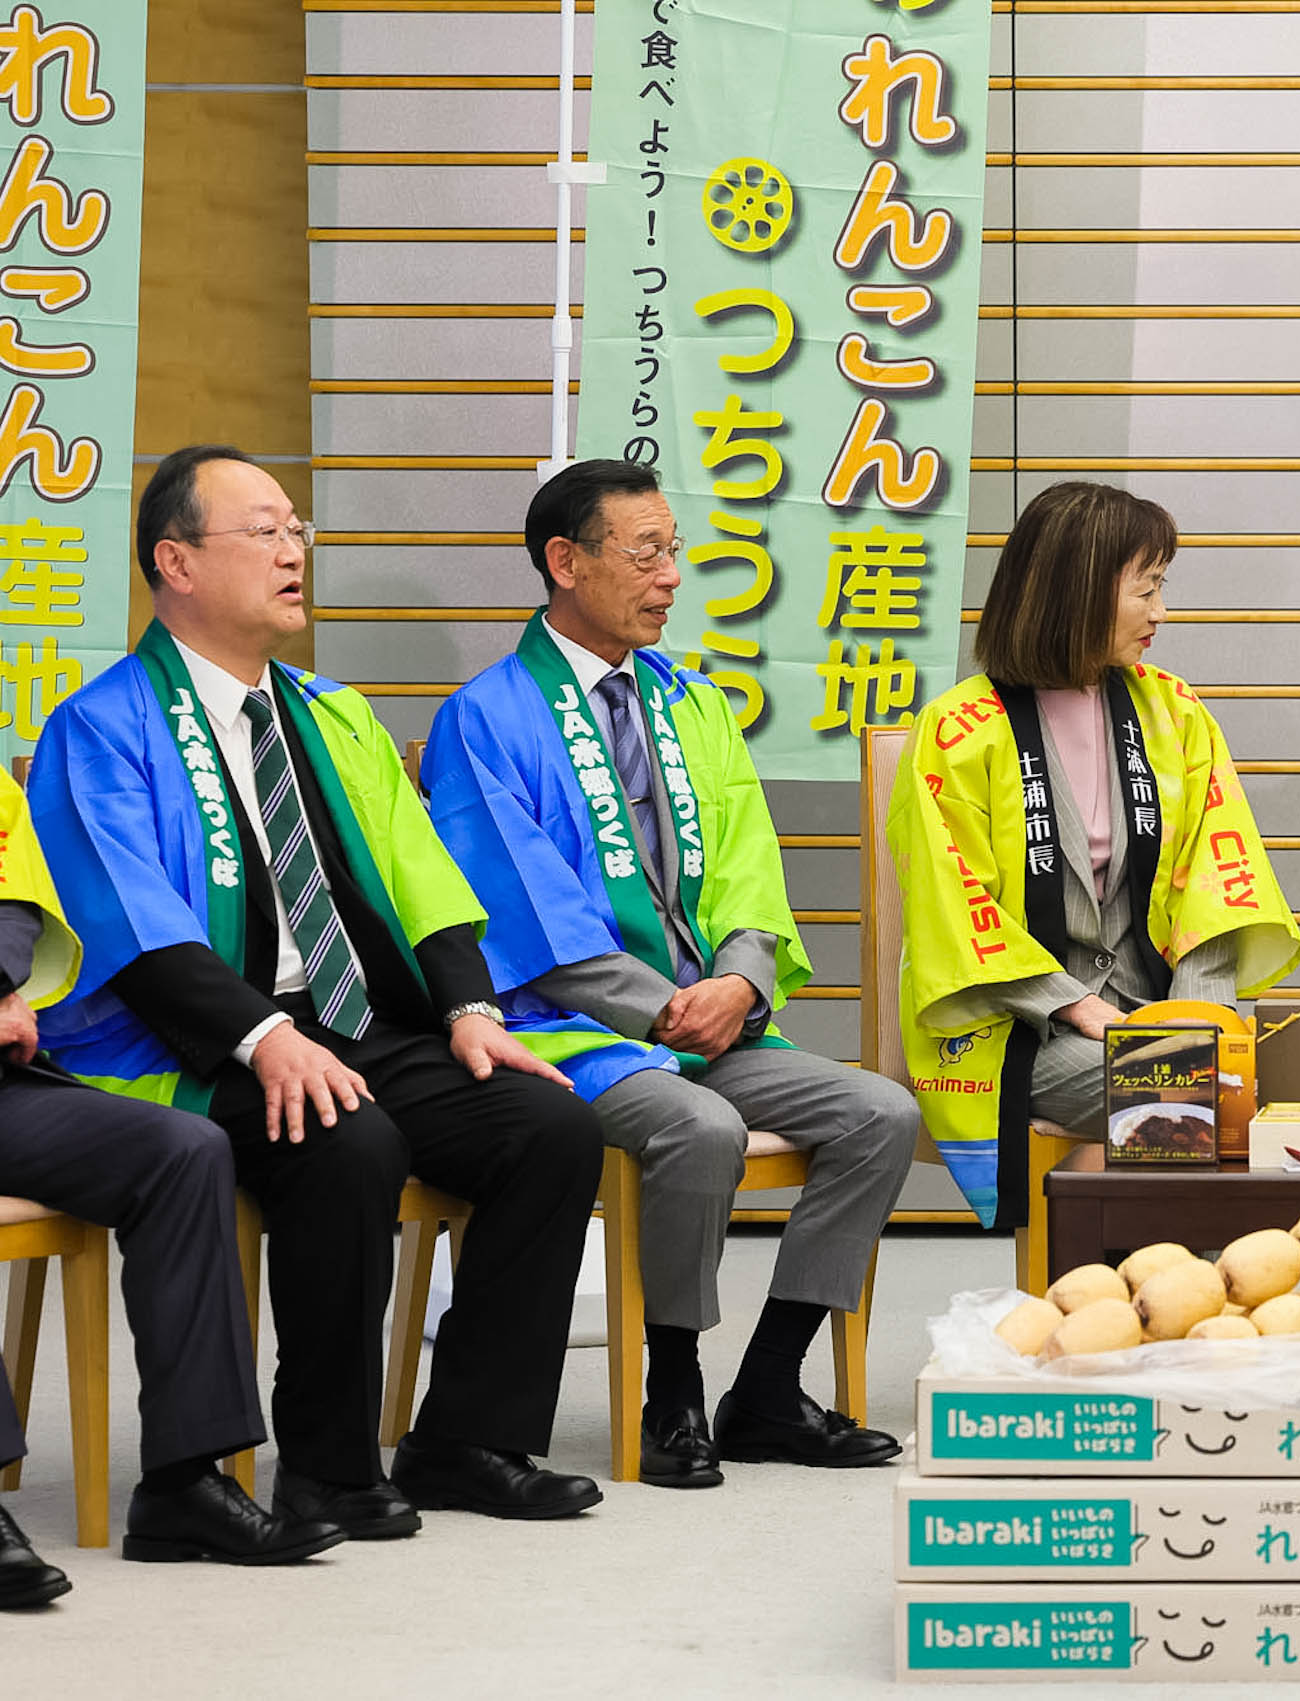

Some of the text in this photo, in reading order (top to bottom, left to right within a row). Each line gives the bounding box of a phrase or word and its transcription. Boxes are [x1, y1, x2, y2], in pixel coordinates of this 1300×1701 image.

[809, 0, 958, 740] れんこん産地
[686, 288, 796, 736] つちうら
[935, 688, 1006, 751] City
[553, 683, 638, 880] JA水郷つくば
[648, 685, 704, 879] JA水郷つくば
[1122, 720, 1157, 838] 土浦市長
[1019, 751, 1056, 876] 土浦市長
[1209, 829, 1260, 910] City
[1112, 1074, 1210, 1087] ツェッペリンカレー
[947, 1408, 1065, 1439] Ibaraki
[1073, 1402, 1137, 1417] いいもの
[1073, 1438, 1137, 1454] いばらき
[1051, 1507, 1115, 1522] いいもの
[924, 1515, 1043, 1546] Ibaraki
[1051, 1543, 1115, 1559] いばらき
[923, 1618, 1042, 1648] Ibaraki
[1050, 1610, 1114, 1625] いいもの
[1050, 1645, 1114, 1661] いばらき
